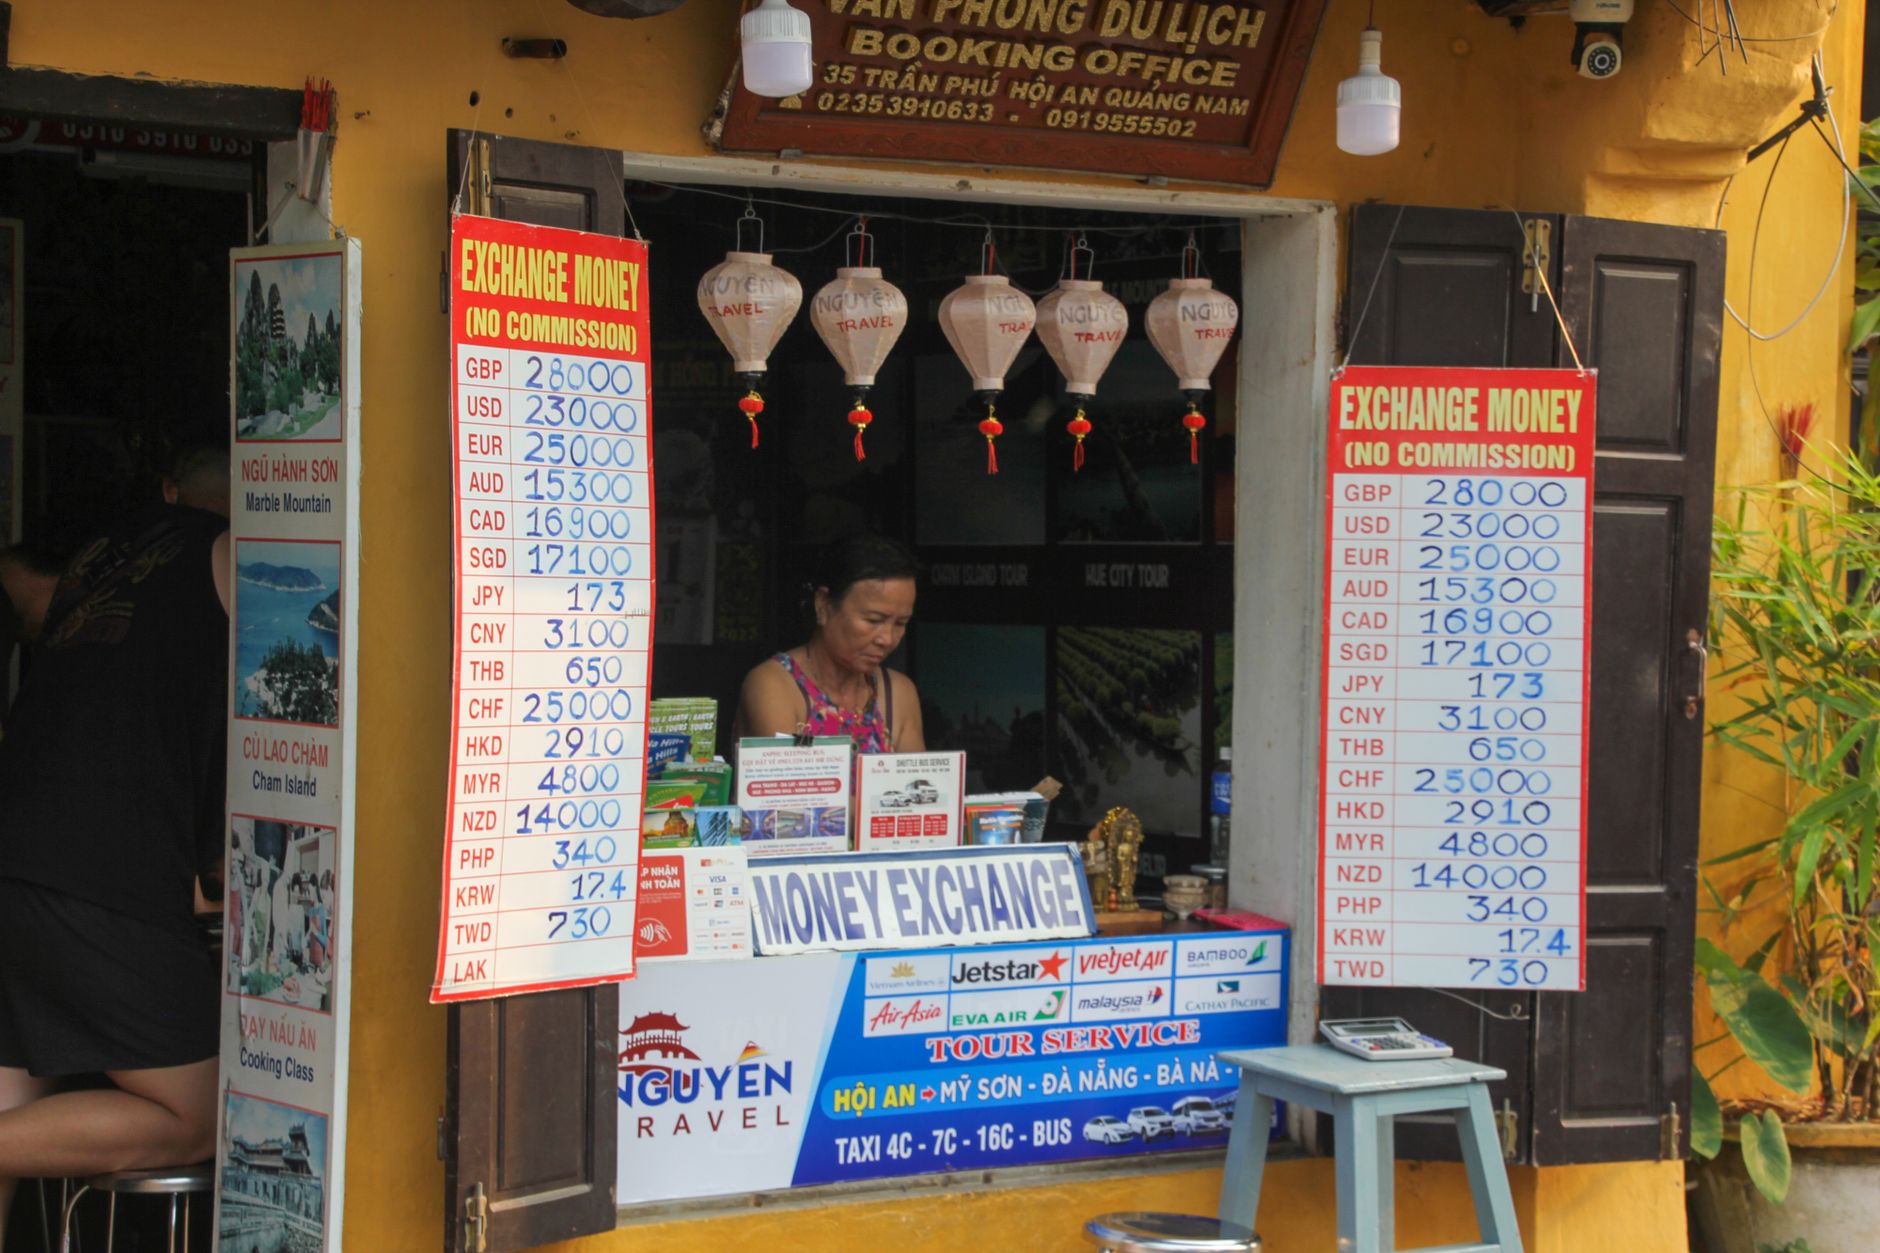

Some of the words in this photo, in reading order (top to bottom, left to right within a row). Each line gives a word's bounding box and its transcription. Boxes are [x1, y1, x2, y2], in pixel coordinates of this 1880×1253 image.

[1100, 4, 1159, 42] DU
[1166, 8, 1266, 54] LỊCH
[850, 29, 1075, 72] BOOKING
[1084, 49, 1240, 88] OFFICE
[824, 64, 856, 85] 35
[865, 60, 938, 94] TRẦN
[947, 69, 1000, 98] PHÚ
[1009, 77, 1055, 109] HỘI
[1062, 83, 1098, 106] AN
[1105, 79, 1189, 112] QUẢNG
[1195, 94, 1249, 116] NAM
[818, 94, 994, 122] 02353910633
[1046, 108, 1197, 138] 0919555502
[461, 238, 568, 303] EXCHANGE
[574, 254, 640, 311] MONEY
[466, 307, 500, 338] (NO
[506, 311, 637, 355] COMMISSION)
[836, 315, 894, 333] TRAVEL
[466, 357, 502, 381] GBP
[525, 356, 632, 395] 28000
[467, 395, 502, 418] USD
[525, 395, 637, 432] 23000
[1339, 385, 1480, 432] EXCHANGE
[1487, 388, 1583, 433] MONEY
[468, 434, 502, 456] EUR
[524, 431, 635, 467] 25000
[1345, 441, 1390, 469] (NO
[1398, 442, 1575, 472] COMMISSION)
[242, 453, 269, 482] NGŨ
[272, 453, 307, 483] HÀNH
[311, 459, 338, 482] SƠN
[469, 471, 504, 494] AUD
[524, 469, 633, 503] 15300
[1344, 484, 1392, 502] GBP
[1425, 478, 1567, 507] 28000
[246, 492, 280, 512] Marble
[283, 493, 331, 513] Mountain
[470, 509, 505, 531] CAD
[526, 507, 630, 540] 16900
[1345, 516, 1390, 534] USD
[1420, 512, 1559, 539] 23000
[470, 546, 506, 570] SGD
[528, 544, 632, 576] 17100
[1344, 548, 1389, 566] EUR
[1419, 544, 1560, 572] 25000
[1085, 562, 1109, 587] HUE
[1110, 562, 1134, 587] CITY
[1137, 563, 1169, 588] TOUR
[1343, 580, 1388, 598] AUD
[1418, 577, 1556, 604] 15300
[472, 585, 505, 606] JPY
[567, 581, 624, 611] 173
[470, 622, 506, 644] CNY
[544, 618, 629, 649] 3100
[1342, 611, 1388, 629] CAD
[1419, 608, 1552, 635] 16900
[1340, 643, 1388, 661] SGD
[1420, 641, 1551, 667] 17100
[470, 660, 504, 681] THB
[566, 655, 622, 687] 650
[1342, 676, 1384, 693] JPY
[1468, 672, 1544, 699] 173
[469, 697, 504, 720] CHF
[522, 689, 631, 723] 25000
[1339, 707, 1386, 724] CNY
[1438, 705, 1546, 731] 3100
[243, 731, 261, 761] CÙ
[263, 738, 288, 763] LAO
[292, 735, 329, 768] CHÀM
[466, 734, 503, 757] HKD
[544, 727, 624, 758] 2910
[1339, 738, 1384, 756] THB
[1469, 737, 1546, 762] 650
[252, 769, 282, 793] Cham
[285, 772, 317, 797] Island
[463, 772, 501, 795] MYR
[538, 764, 619, 794] 4800
[1339, 770, 1383, 788] CHF
[1413, 767, 1551, 795] 25000
[462, 810, 497, 833] NZD
[516, 799, 620, 834] 14000
[1337, 802, 1384, 819] HKD
[1444, 798, 1550, 826] 2910
[460, 847, 495, 870] PHP
[552, 835, 616, 870] 340
[1336, 834, 1384, 851] MYR
[1438, 831, 1548, 858] 4800
[456, 884, 495, 908] KRW
[572, 871, 626, 900] 17.4
[709, 875, 726, 883] VISA
[1337, 865, 1382, 883] NZD
[1411, 863, 1546, 890] 14000
[752, 869, 884, 946] MONEY
[889, 859, 1081, 936] EXCHANGE
[1337, 898, 1382, 914] PHP
[1466, 895, 1548, 922] 340
[455, 921, 491, 945] TWD
[548, 906, 611, 939] 730
[1187, 948, 1248, 962] BAMBOO
[1333, 929, 1385, 946] KRW
[1498, 928, 1571, 956] 17.4
[454, 959, 488, 983] LAK
[952, 960, 1039, 984] Jetstar
[1334, 961, 1384, 978] TWD
[1468, 958, 1548, 986] 730
[952, 1013, 989, 1026] EVA
[994, 1010, 1027, 1023] AIR
[1078, 995, 1143, 1014] malaysia
[1185, 999, 1227, 1013] CATHAY
[1230, 997, 1270, 1009] PACIFIC
[270, 1012, 295, 1045] NẤU
[927, 1032, 1034, 1062] TOUR
[1042, 1019, 1201, 1054] SERVICE
[240, 1047, 282, 1080] Cooking
[285, 1056, 314, 1083] Class
[618, 1061, 792, 1108] NGUYEN
[833, 1082, 875, 1117] HỘI
[883, 1083, 916, 1108] AN
[939, 1075, 972, 1104] MỸ
[977, 1074, 1022, 1100] SƠN
[1041, 1066, 1073, 1096] ĐÀ
[1078, 1058, 1138, 1092] NẴNG
[1156, 1057, 1185, 1087] BÀ
[1191, 1054, 1219, 1083] NÀ
[637, 1105, 789, 1138] RAVEL
[835, 1133, 880, 1164] TAXI
[886, 1130, 912, 1160] 4C
[932, 1127, 957, 1156] 7C
[977, 1122, 1014, 1151] 16C
[1033, 1117, 1072, 1147] BUS
